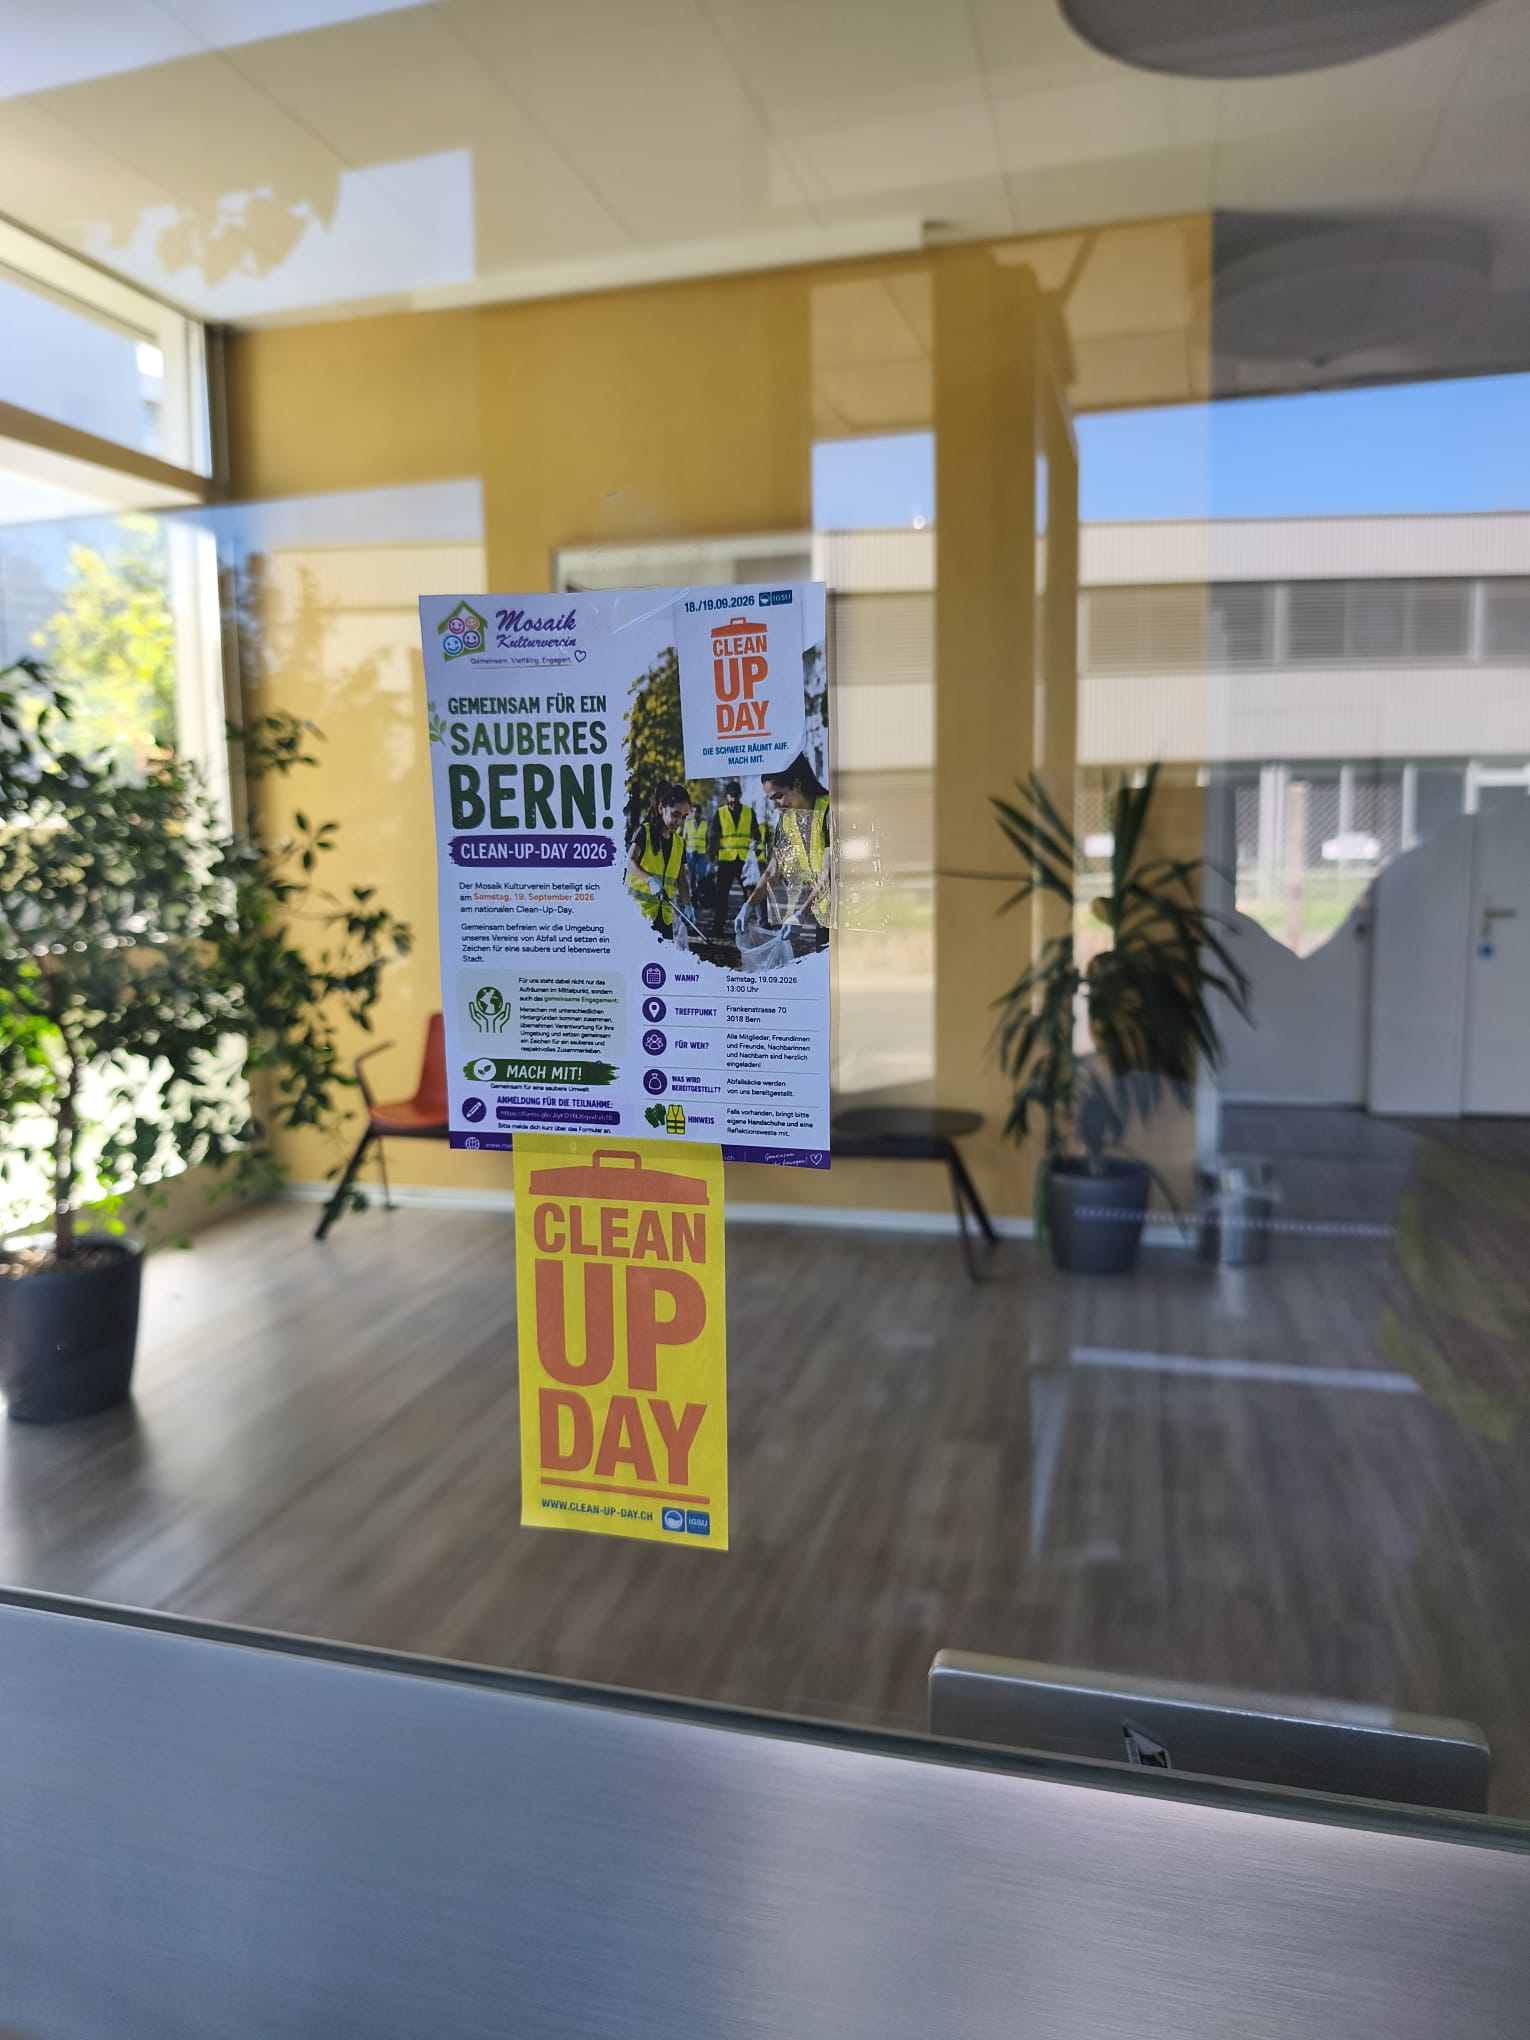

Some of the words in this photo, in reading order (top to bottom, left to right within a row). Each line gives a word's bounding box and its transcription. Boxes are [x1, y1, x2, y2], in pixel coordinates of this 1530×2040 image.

[685, 596, 754, 613] 18./19.09.2026
[496, 609, 576, 632] Mosaik
[496, 634, 576, 648] Kulturverein
[712, 635, 767, 657] CLEAN
[713, 656, 768, 702] UP
[448, 696, 540, 714] GEMEINSAM
[546, 693, 575, 714] FÜR
[581, 695, 606, 712] EIN
[716, 701, 769, 733] DAY
[450, 721, 608, 755] SAUBERES
[716, 745, 746, 754] SCHWEIZ
[748, 743, 772, 752] RÄUMT
[774, 742, 789, 750] AUF.
[728, 757, 748, 765] MACH
[751, 755, 764, 763] MIT.
[448, 763, 613, 830] BERN!
[461, 843, 568, 859] CLEAN-UP-DAY
[573, 843, 607, 859] 2026
[459, 882, 473, 890] Der
[475, 882, 501, 890] Mosaik
[552, 883, 583, 891] beteiligt
[474, 893, 511, 902] Samstag,
[528, 893, 572, 901] September
[516, 906, 574, 915] Clean-Up-Day.
[461, 923, 505, 931] Gemeinsam
[565, 924, 604, 933] Umgebung
[492, 934, 518, 942] Vereins
[568, 946, 610, 954] lebenswerte
[463, 955, 485, 963] Stadt.
[674, 974, 699, 982] WANN?
[726, 976, 757, 984] Samstag,
[675, 1008, 717, 1016] TREFFPUNKT
[727, 1006, 776, 1014] Frankenstrasse
[739, 1034, 771, 1042] Mitglieder,
[675, 1041, 688, 1049] FÜR
[690, 1042, 709, 1050] WEN?
[784, 1053, 808, 1061] herzlich
[727, 1061, 761, 1069] eingeladen!
[507, 1065, 546, 1079] MACH
[552, 1066, 582, 1080] MIT!
[672, 1085, 721, 1093] BEREITGESTELLT?
[752, 1089, 795, 1097] bereitgestellt.
[497, 1096, 540, 1105] ANMELDUNG
[543, 1096, 556, 1106] FÜR
[559, 1098, 569, 1107] DIE
[573, 1100, 613, 1109] TEILNAHME:
[741, 1109, 774, 1117] vorhanden,
[776, 1110, 793, 1118] bringt
[688, 1116, 714, 1124] HINWEIS
[533, 1202, 706, 1264] CLEAN
[535, 1258, 707, 1392] UP
[538, 1387, 708, 1486] DAY
[541, 1497, 654, 1522] WWW.CLEAN-UP-DAY.CH
